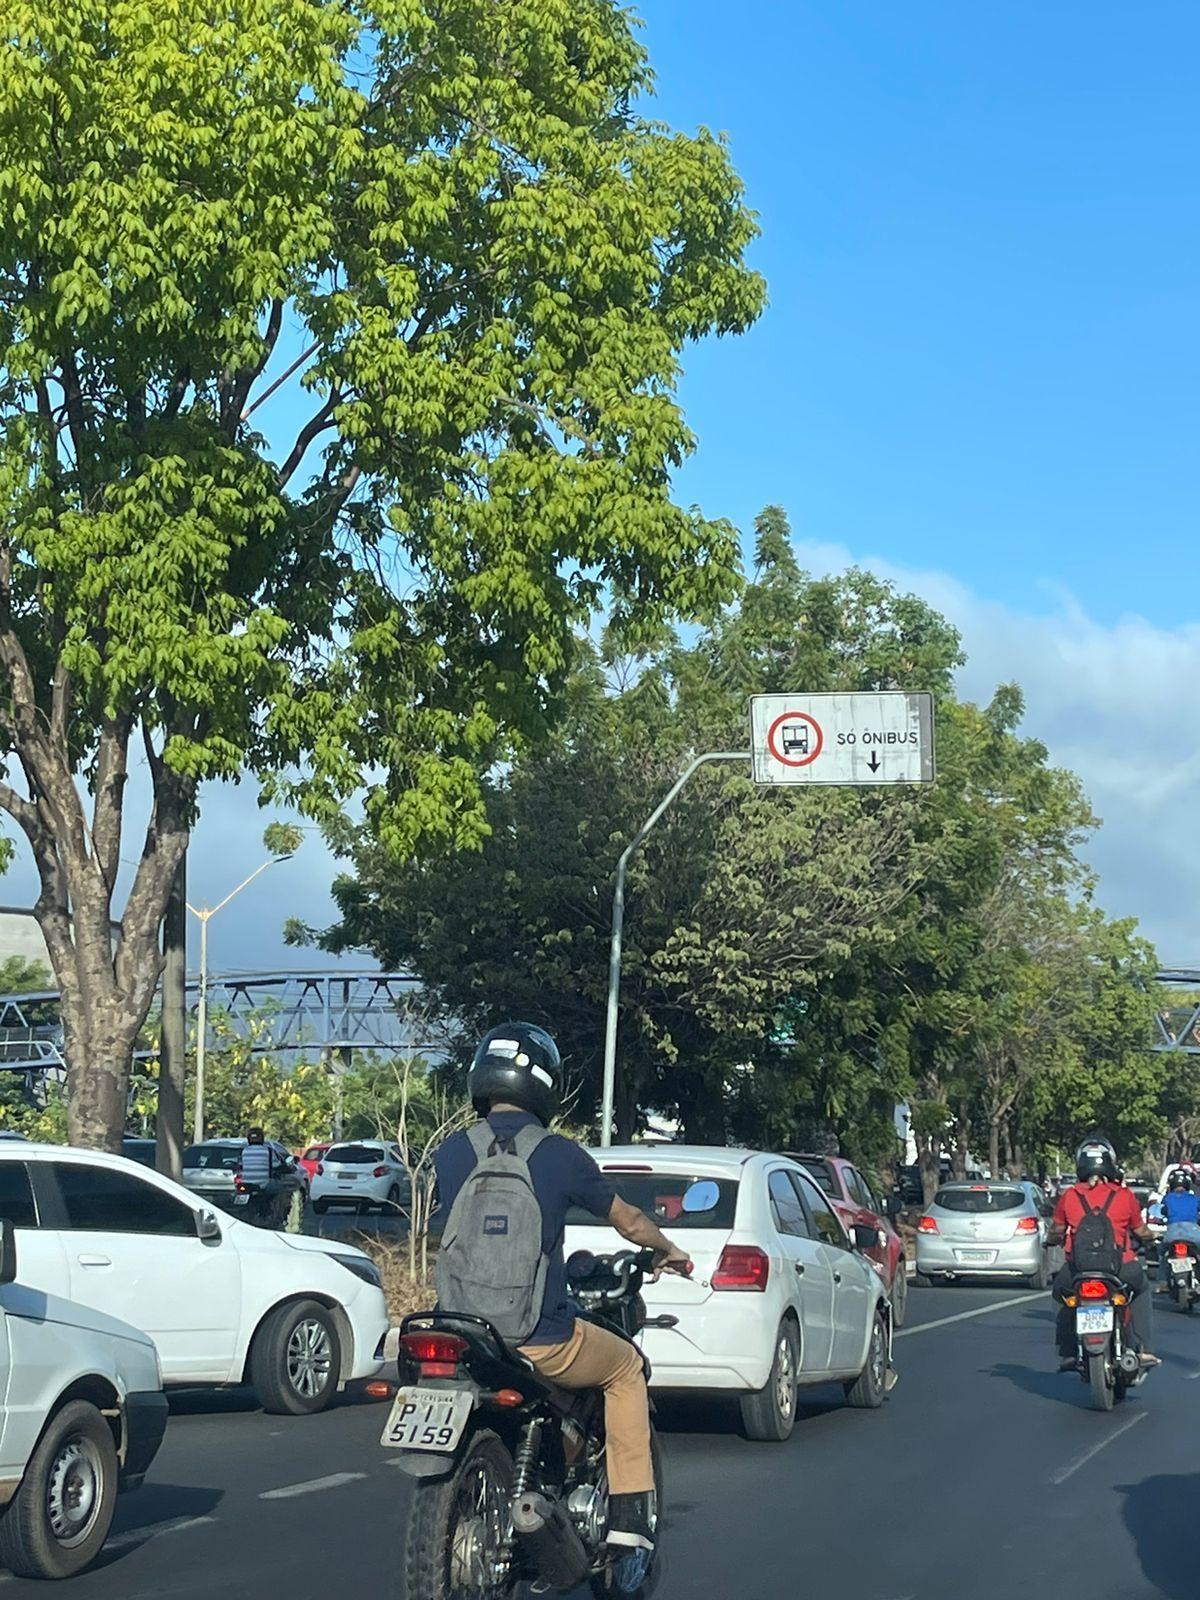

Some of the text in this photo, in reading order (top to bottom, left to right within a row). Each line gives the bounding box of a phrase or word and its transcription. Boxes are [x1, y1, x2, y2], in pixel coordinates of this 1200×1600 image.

[837, 728, 918, 745] SÓ ÔNIBUS
[389, 1424, 454, 1446] 5159
